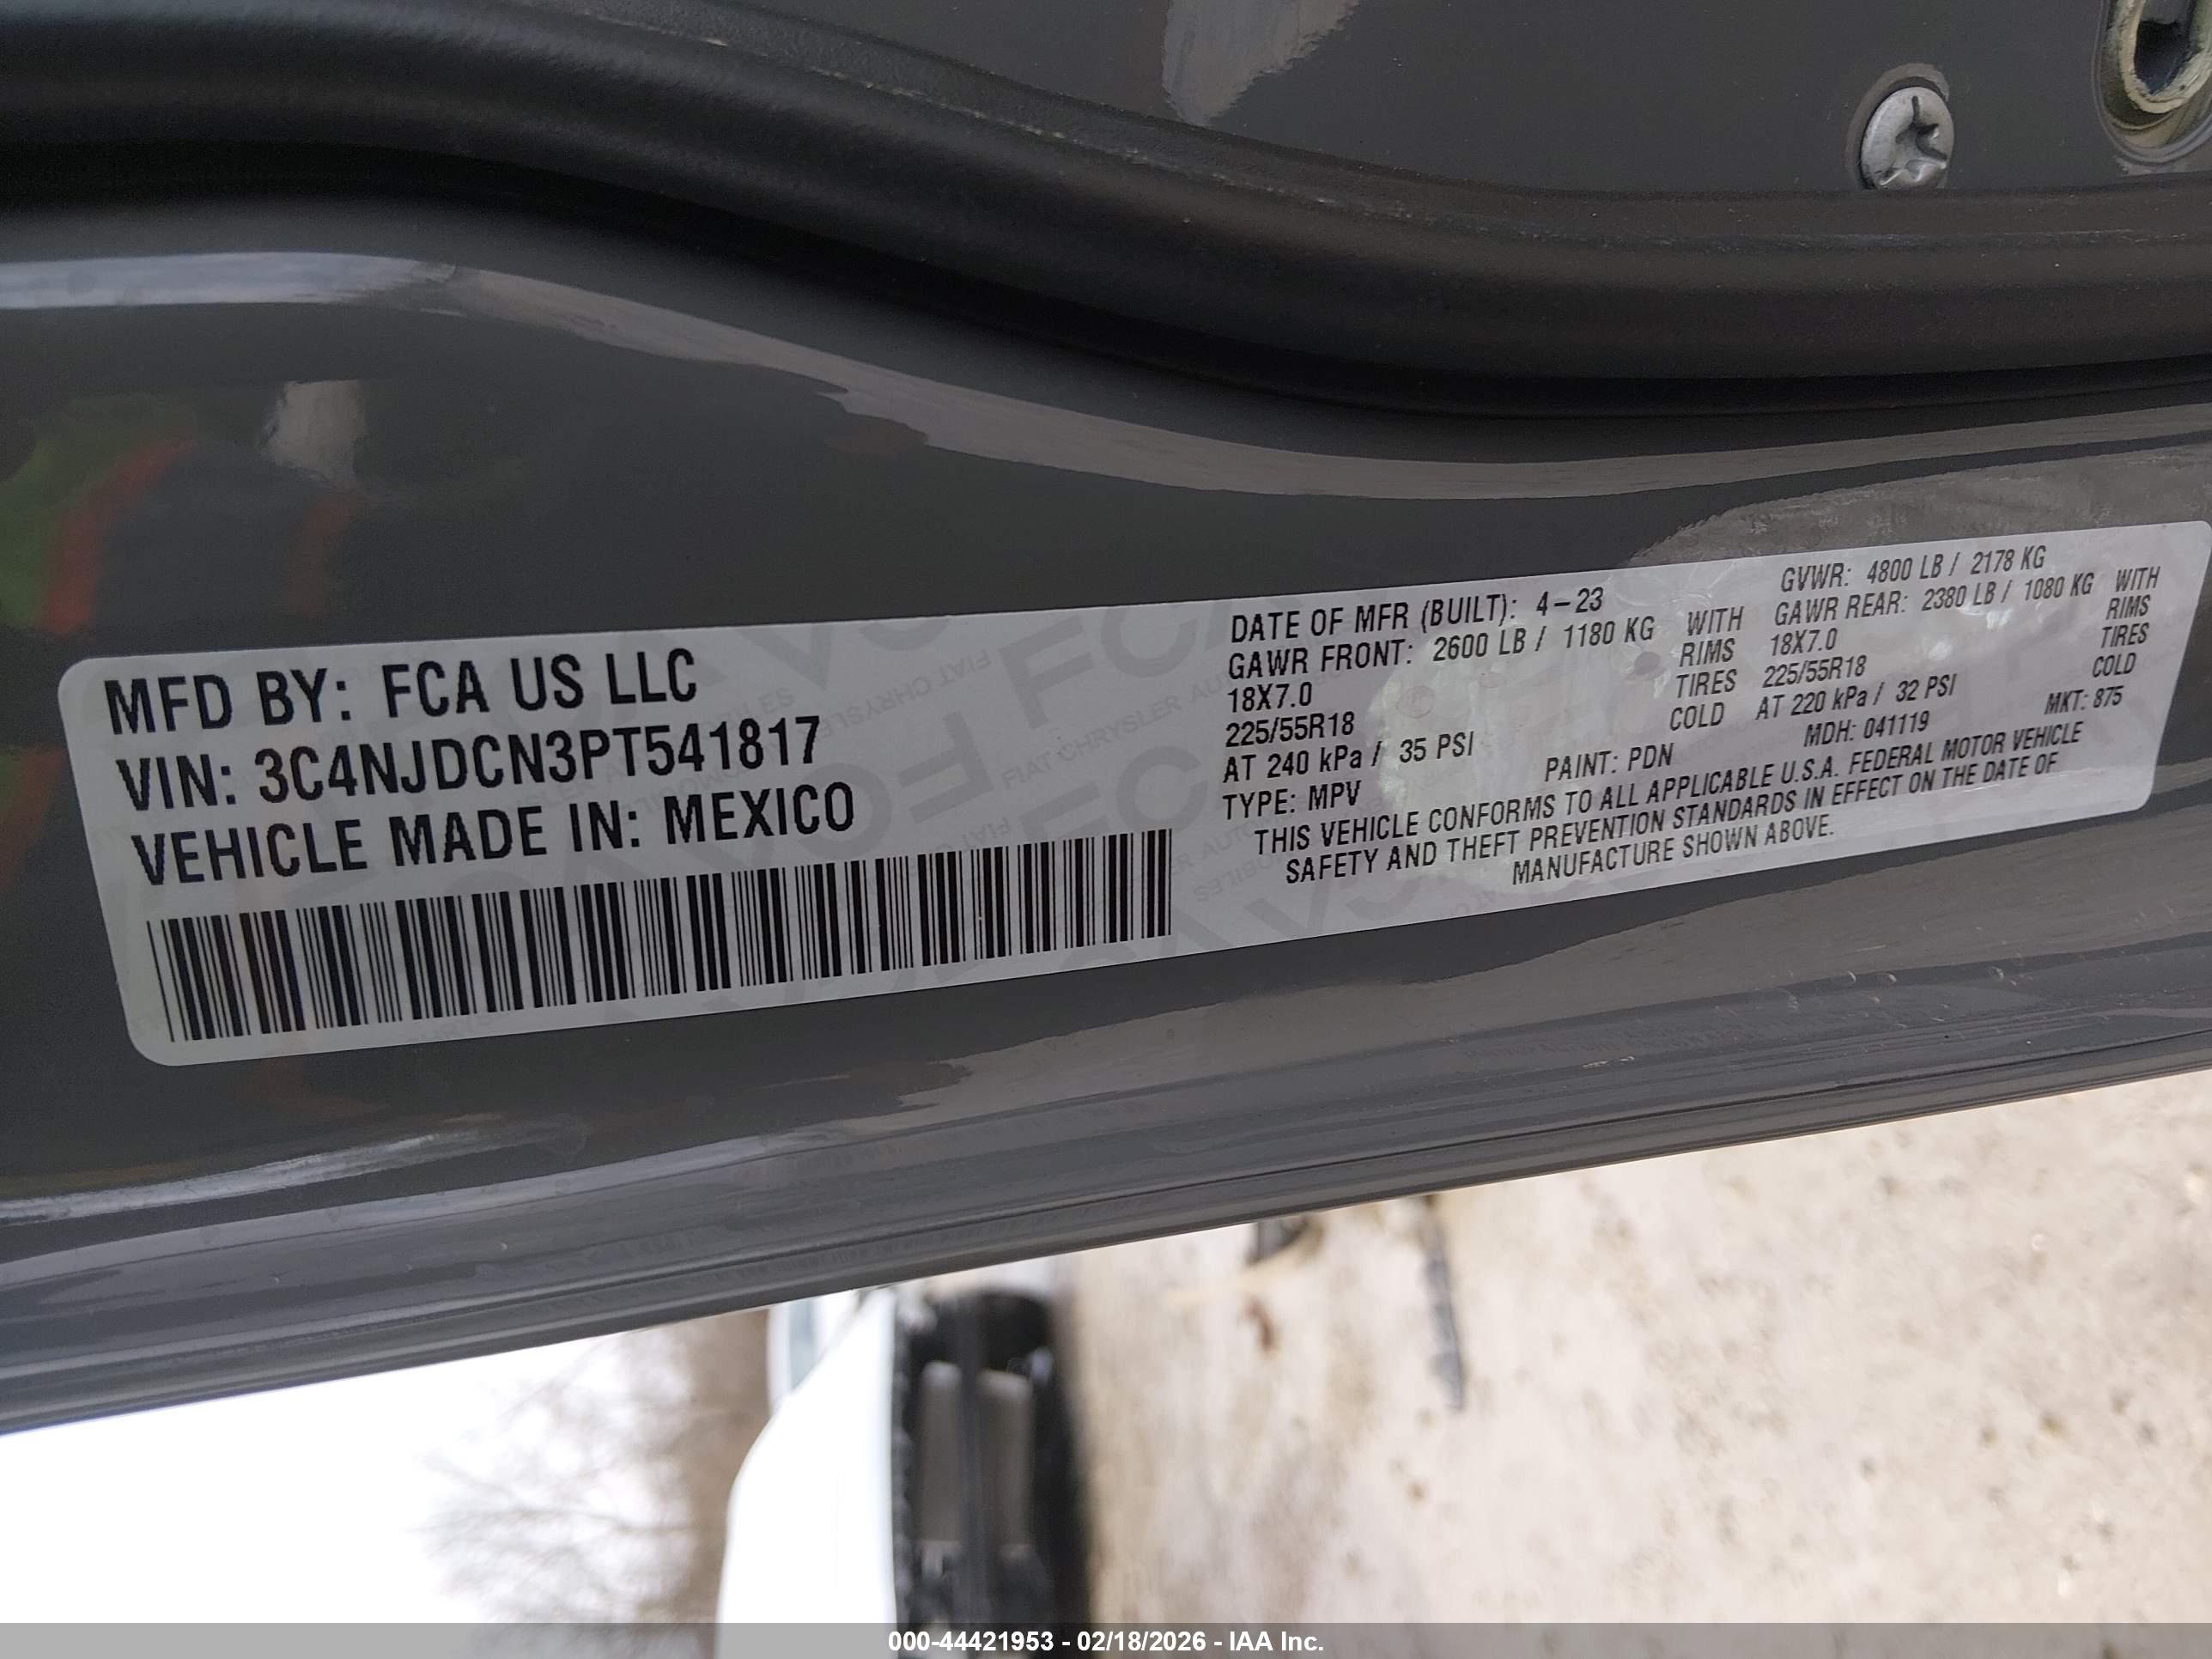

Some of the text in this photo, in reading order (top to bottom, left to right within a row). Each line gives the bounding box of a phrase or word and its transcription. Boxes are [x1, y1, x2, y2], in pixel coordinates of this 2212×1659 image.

[1781, 545, 2045, 592] GVWR: 4800 LB / 2178 KG
[2116, 567, 2160, 592] WITH
[1231, 611, 1300, 643] DATE
[1310, 607, 1344, 636] OF
[1355, 602, 1408, 633] MFR
[1421, 593, 1516, 634] (BUILT):
[1775, 572, 2094, 626] GAWR REAR: 2380 LB / 1080 KG
[2106, 594, 2150, 619] RIMS
[1687, 606, 1743, 636] WITH
[2102, 623, 2149, 647] TIRES
[1229, 616, 1655, 679] GAWR FRONT: 2600 LB / 1180 KG
[1680, 638, 1735, 666] RIMS
[1771, 628, 1838, 655] 18X7.0
[939, 647, 993, 687] FIAT
[1677, 669, 1737, 698] TIRES
[1763, 655, 1867, 688] 225/55R18
[2093, 653, 2136, 678] COLD
[104, 647, 696, 735] MFD BY: FCA US LLC
[1228, 682, 1312, 713] 18X7.0
[1756, 674, 1956, 720] AT 220 kPa / 32 PSI
[2045, 685, 2124, 714] MKT: 875
[1225, 711, 1354, 747] 225/55R18
[1670, 702, 1724, 731] COLD
[1804, 710, 1929, 747] MDH: 041119
[1002, 694, 1182, 789] FIAT CHRYSLER
[1223, 732, 1474, 783] AT 240 kPa / 35 PSI
[115, 754, 236, 811] VIN:
[254, 715, 820, 803] 3C4NJDCN3PT541817
[1545, 743, 1674, 781] PAINT: PDN
[1222, 788, 1295, 820] TYPE:
[1309, 780, 1361, 811] MPV
[1255, 824, 1310, 854] THIS
[1321, 811, 1419, 847] VEHICLE
[1429, 794, 1555, 833] CONFORMS
[1565, 789, 1592, 815] TO
[1600, 783, 1638, 811] ALL
[1646, 763, 1774, 804] APPLICABLE
[1781, 756, 1839, 784] U.S.A.
[1849, 742, 1933, 775] FEDERAL
[1942, 732, 2006, 761] MOTOR
[2013, 721, 2083, 750] VEHICLE
[131, 819, 368, 885] VEHICLE
[389, 805, 547, 866] MADE
[569, 800, 640, 852] IN:
[664, 781, 854, 844] MEXICO
[1286, 848, 1378, 884] SAFETY
[1387, 842, 1437, 871] AND
[1447, 830, 1520, 862] THEFT
[1530, 810, 1665, 851] PREVENTION
[1674, 790, 1797, 829] STANDARDS
[1804, 786, 1825, 809] IN
[1832, 774, 1903, 805] EFFECT
[1909, 770, 1936, 793] ON
[1943, 763, 1978, 787] THE
[1983, 756, 2030, 782] DATE
[2035, 751, 2058, 775] OF
[1513, 814, 1834, 884] MANUFACTURE SHOWN ABOVE.
